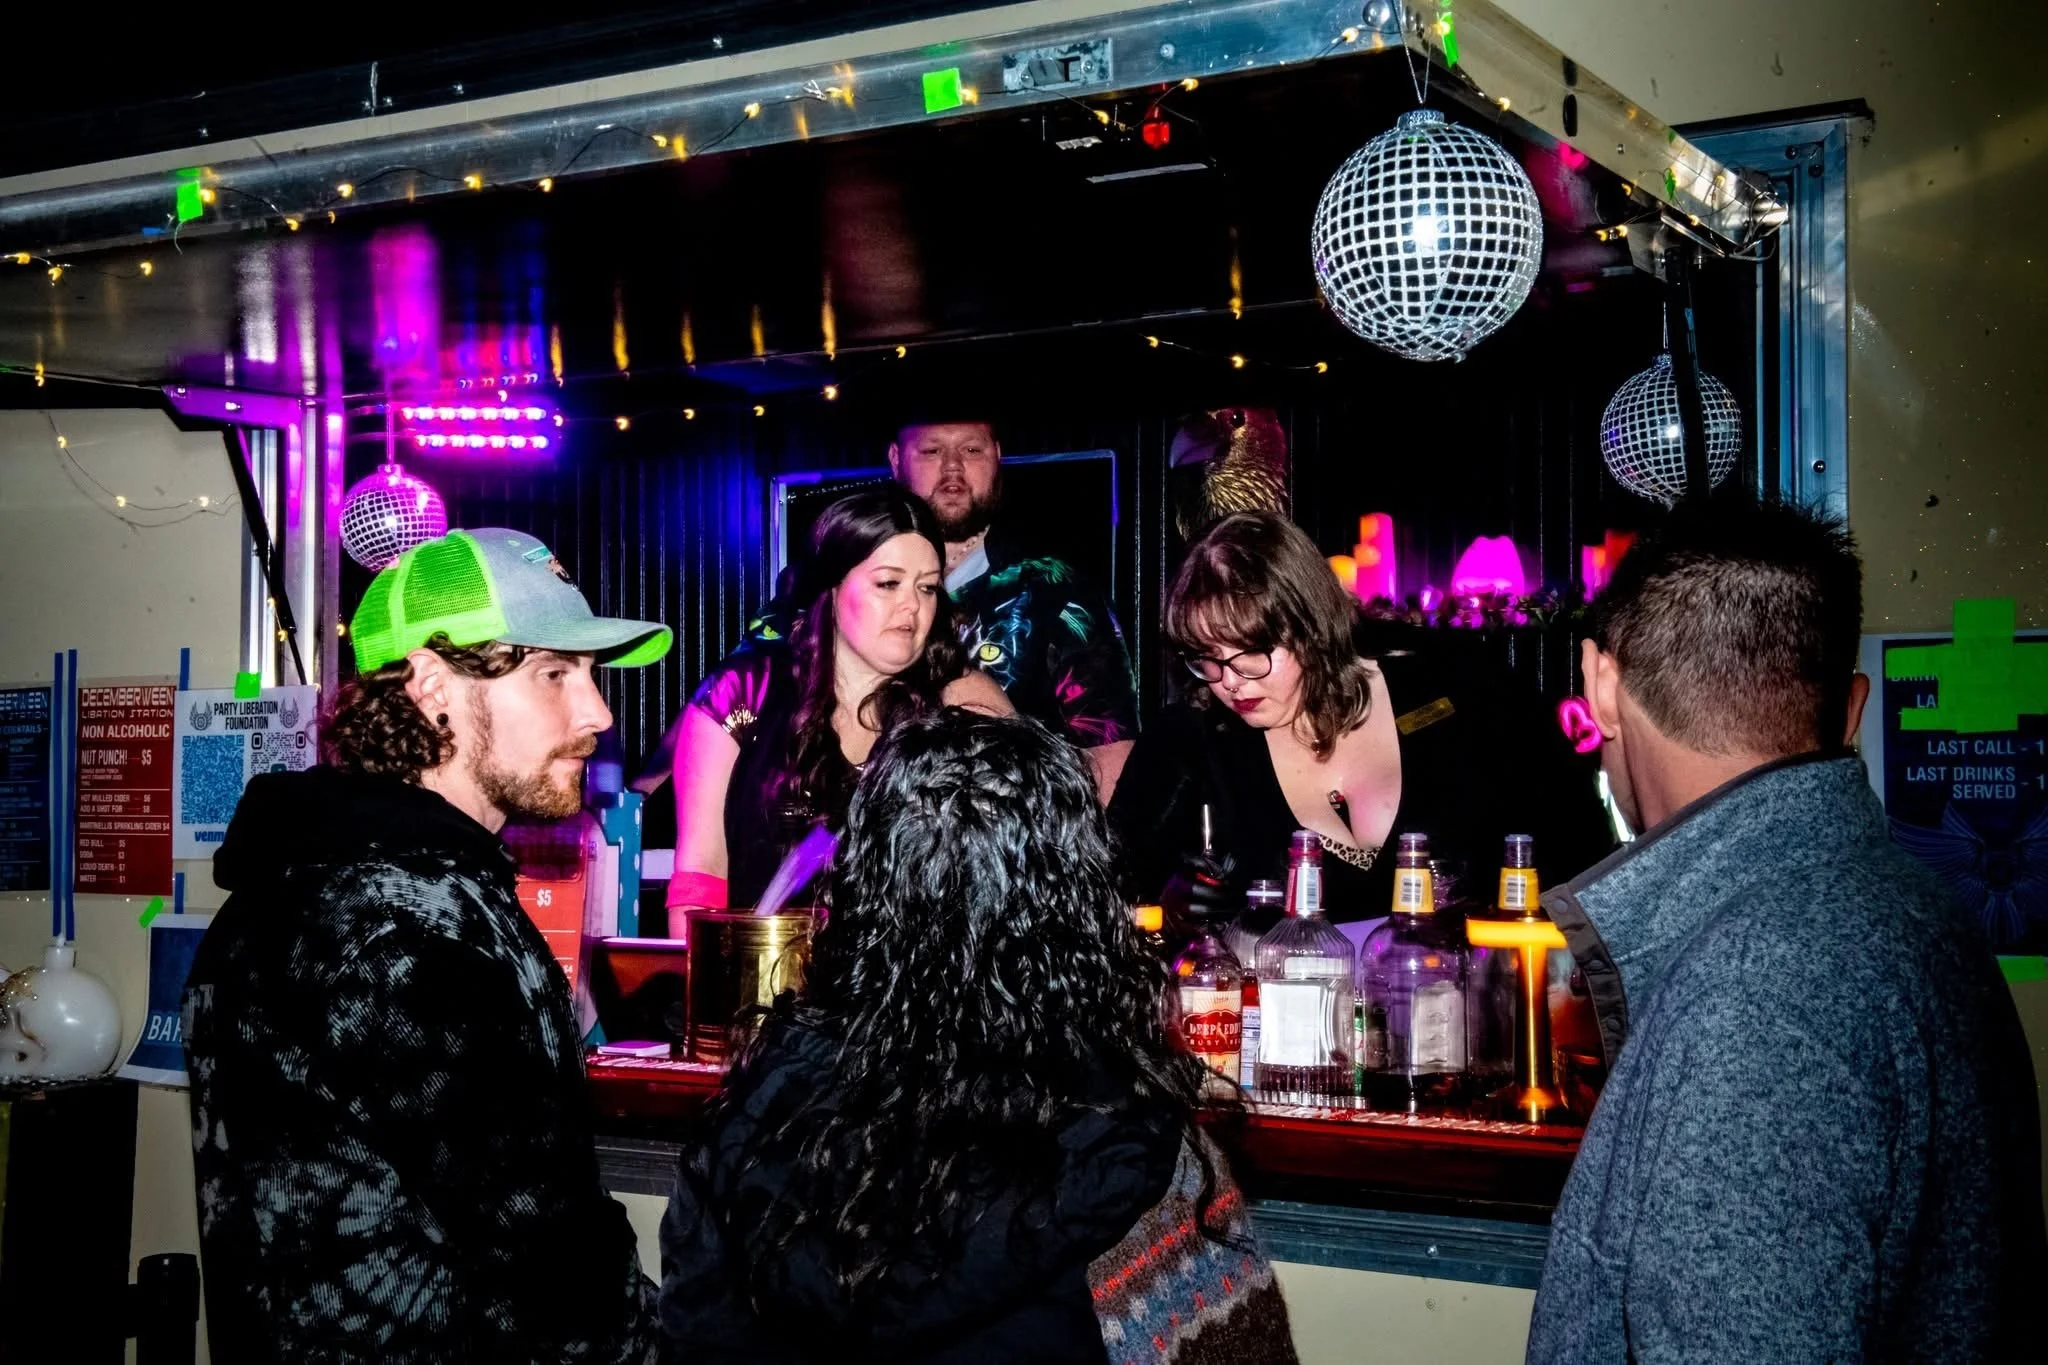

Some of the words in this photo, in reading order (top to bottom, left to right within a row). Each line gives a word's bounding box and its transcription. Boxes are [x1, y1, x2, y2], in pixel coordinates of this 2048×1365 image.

[82, 687, 173, 707] DECEMBERWEEN
[82, 709, 125, 719] LIBATION
[129, 708, 173, 718] STATION
[214, 702, 238, 715] PARTY
[240, 701, 278, 715] LIBERATION
[225, 716, 269, 730] FOUNDATION
[82, 724, 104, 738] NON
[107, 723, 170, 738] ALCOHOLIC
[1927, 740, 1968, 755] LAST
[1974, 740, 2016, 755] CALL
[2036, 740, 2045, 755] 1
[81, 749, 97, 765] NUT
[98, 749, 128, 765] PUNCH!
[141, 748, 152, 766] $5
[1907, 767, 1947, 781] LAST
[1953, 767, 2016, 781] DRINKS
[2036, 774, 2045, 790] 1
[91, 794, 113, 802] MULLED
[114, 794, 130, 802] CIDER
[1953, 784, 2016, 799] SERVED
[111, 805, 123, 813] FOR
[79, 839, 90, 847] RED
[90, 839, 104, 847] BULL
[536, 888, 552, 907] $5
[1189, 1022, 1216, 1036] DEEP
[1190, 1038, 1220, 1046] RUBY
